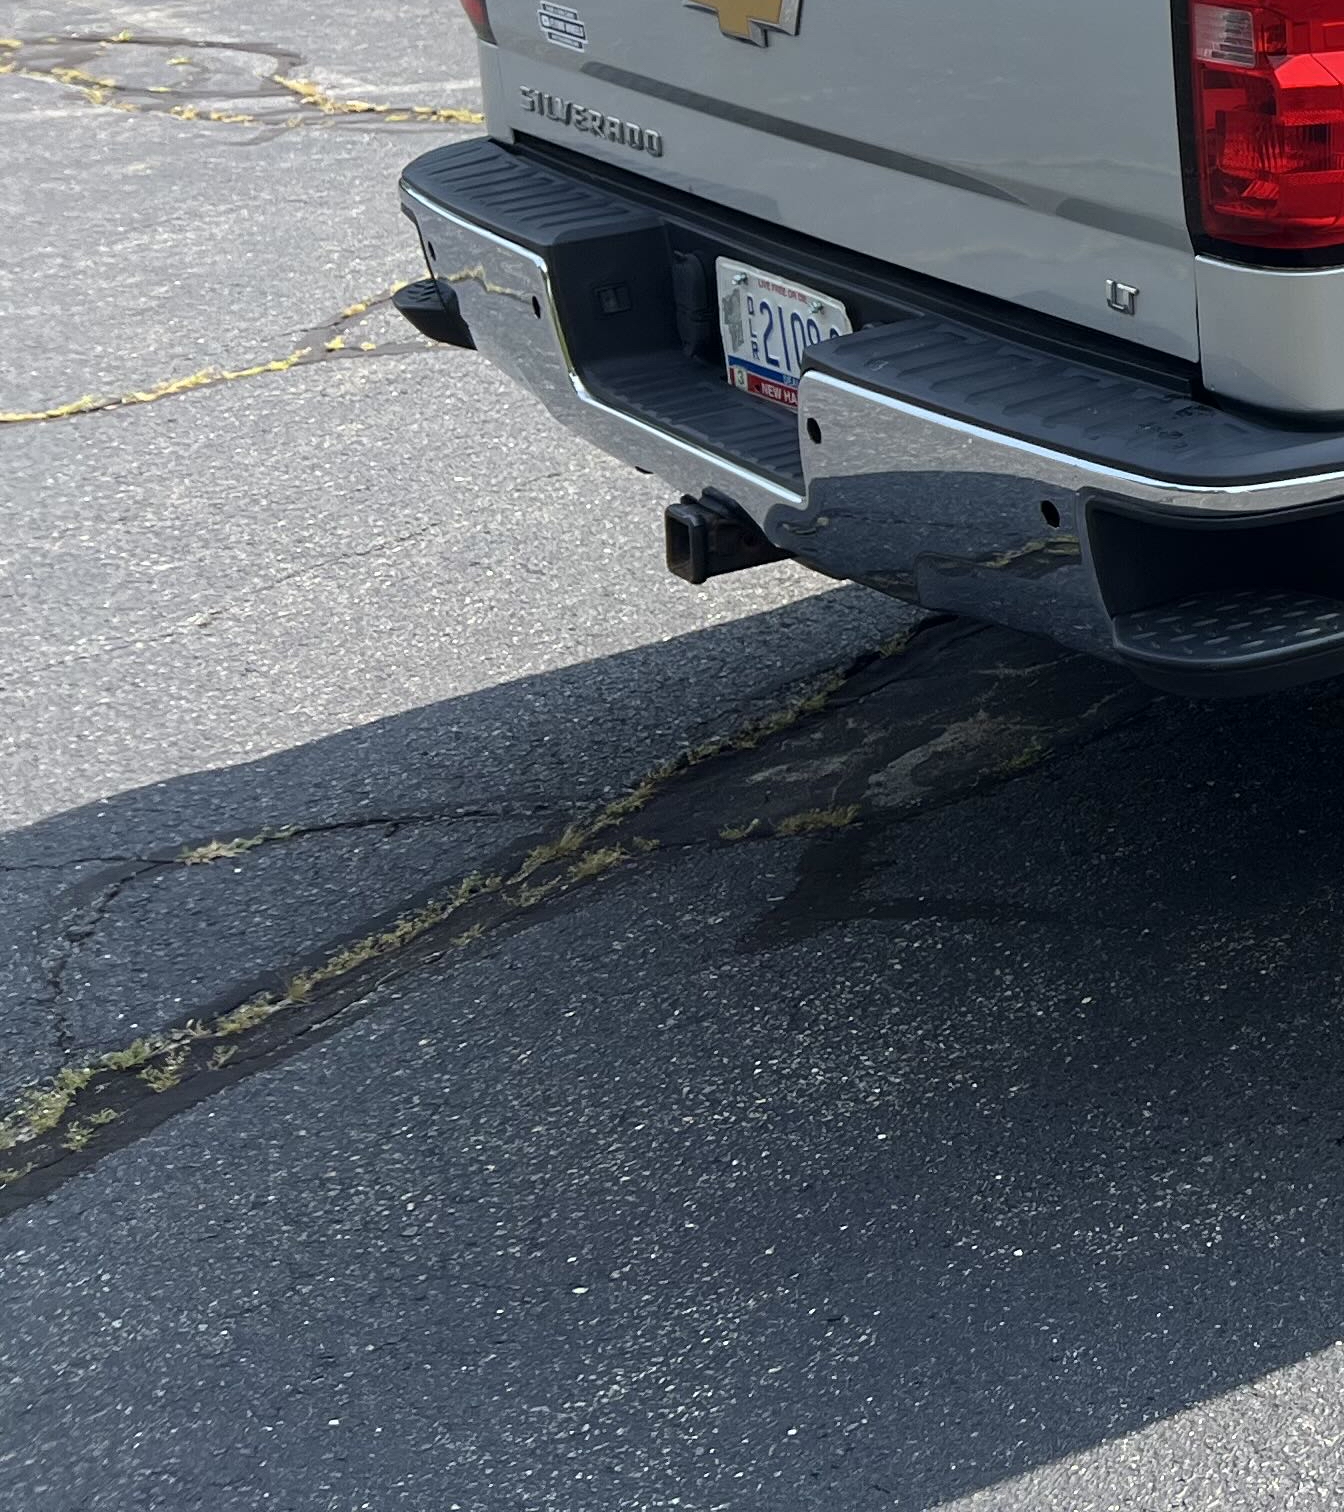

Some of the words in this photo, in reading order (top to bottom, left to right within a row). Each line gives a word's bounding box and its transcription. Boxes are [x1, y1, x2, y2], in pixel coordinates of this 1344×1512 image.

[519, 85, 664, 158] SILVERADO
[771, 282, 787, 297] FREE
[1104, 279, 1139, 315] LT
[761, 382, 781, 400] NEW
